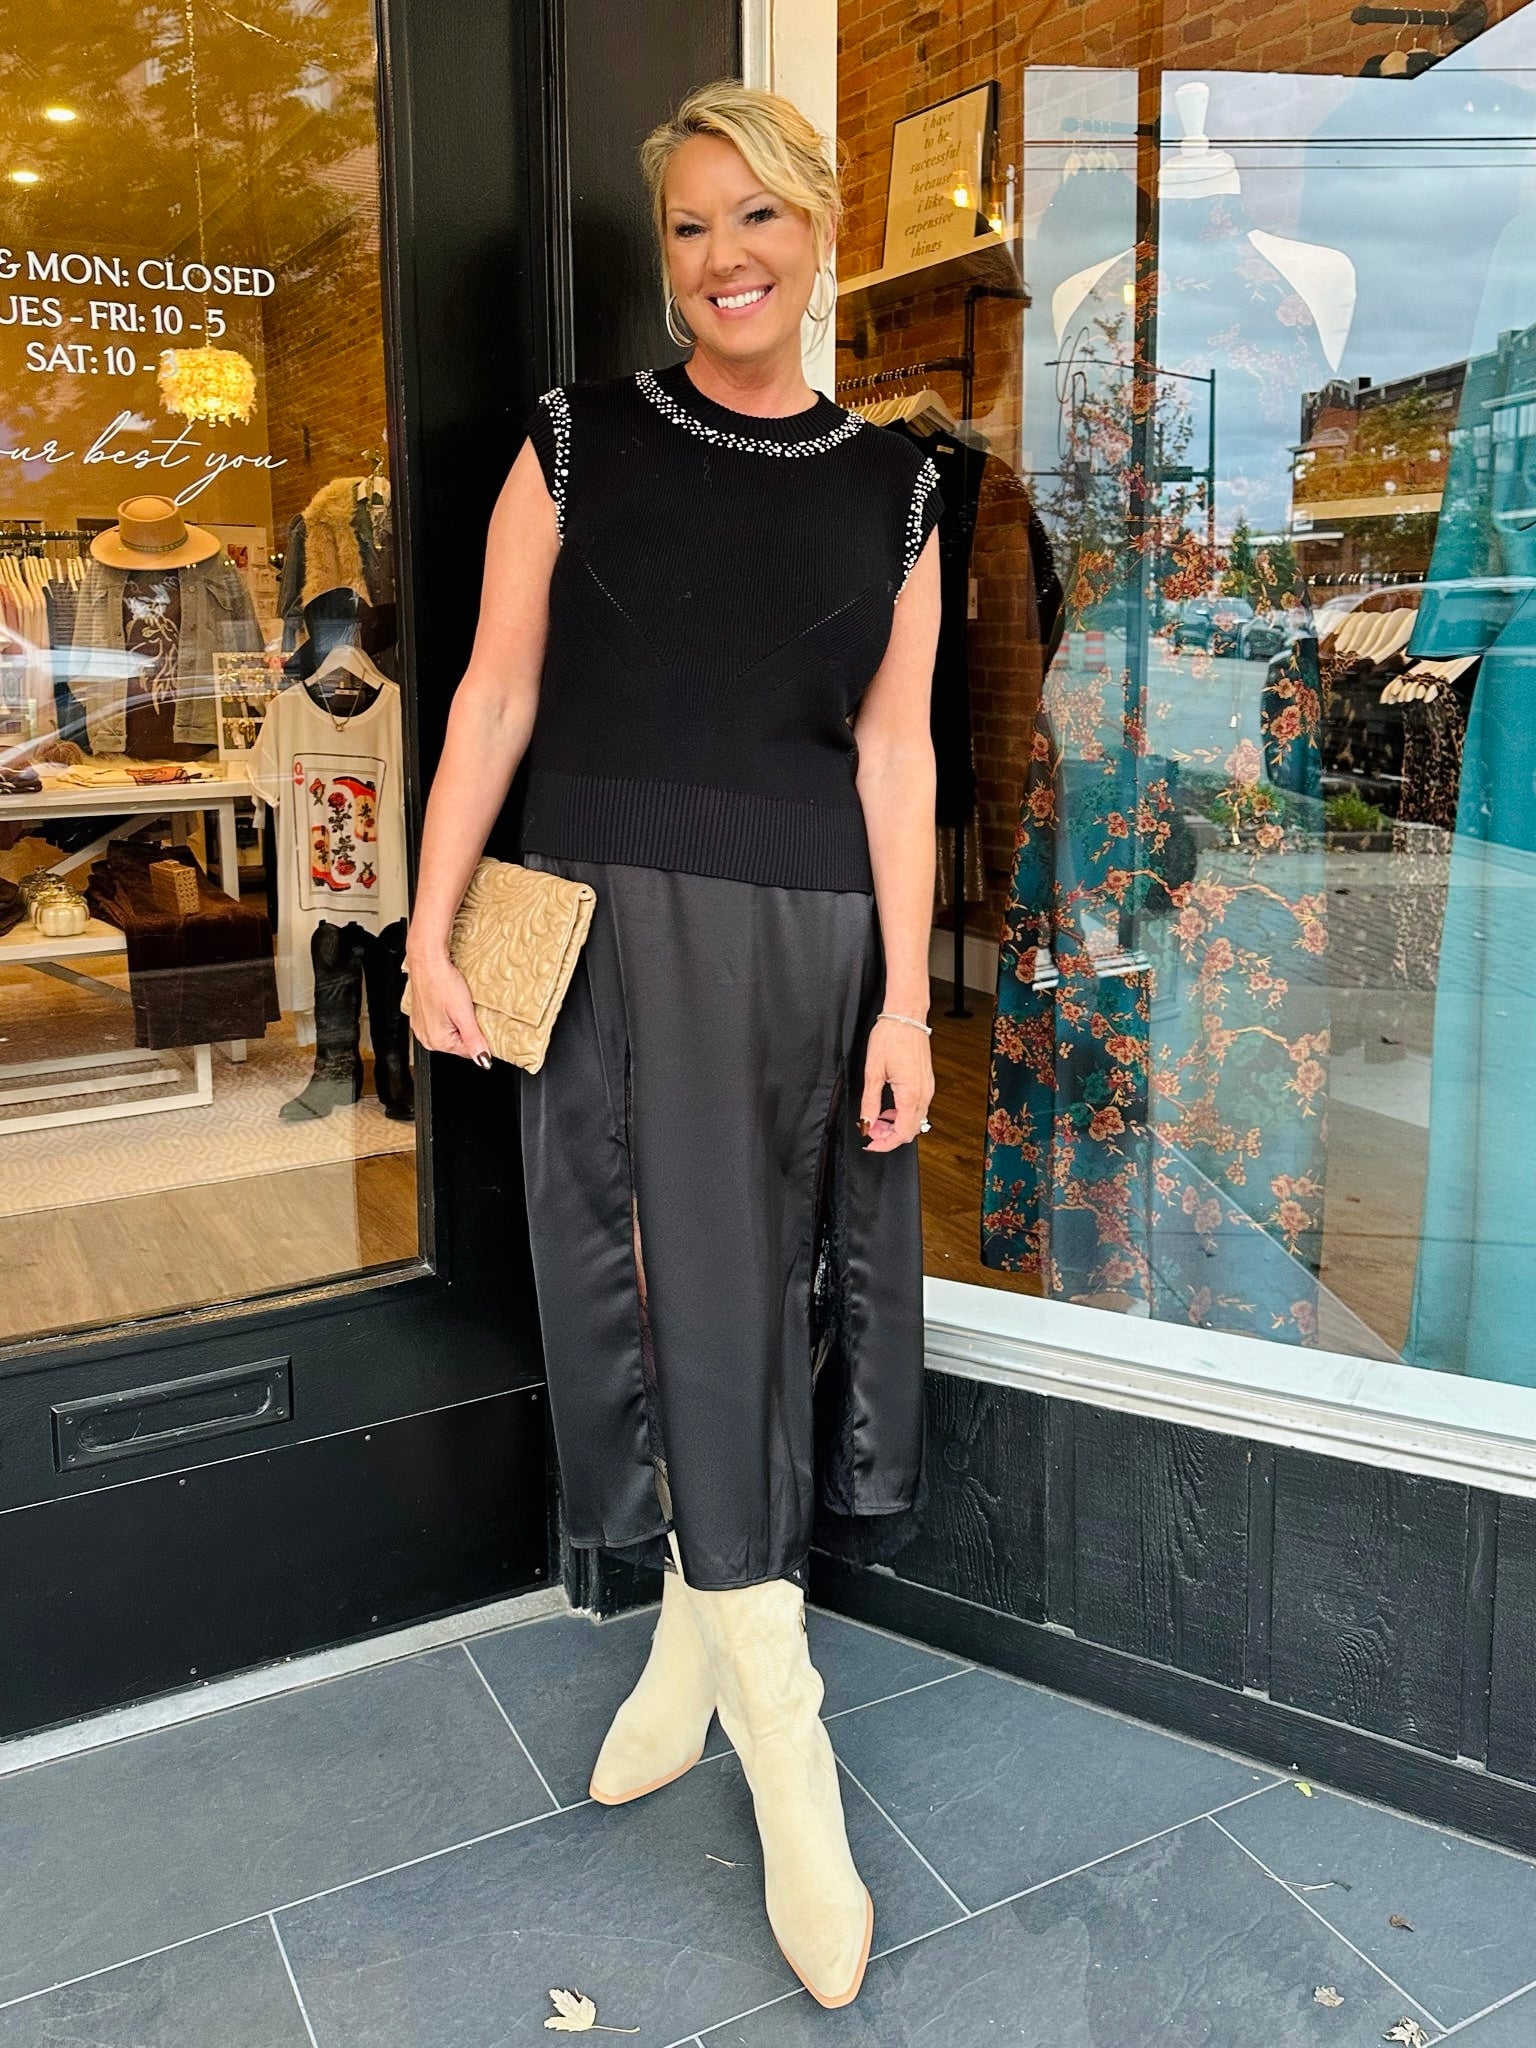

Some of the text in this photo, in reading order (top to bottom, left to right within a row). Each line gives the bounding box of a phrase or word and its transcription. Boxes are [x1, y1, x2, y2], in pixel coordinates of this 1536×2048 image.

[922, 111, 954, 132] i have
[924, 128, 950, 150] to be
[909, 140, 962, 174] successful
[912, 172, 953, 195] because
[917, 193, 944, 213] i like
[904, 212, 954, 238] expensive
[910, 240, 942, 258] things
[0, 248, 276, 297] & MON: CLOSED
[89, 300, 147, 333] FRI:
[151, 304, 184, 335] 10
[206, 308, 227, 338] 5
[26, 341, 99, 375] SAT:
[103, 345, 136, 376] 10
[159, 348, 178, 378] 3
[83, 410, 202, 469] best
[174, 452, 289, 507] you
